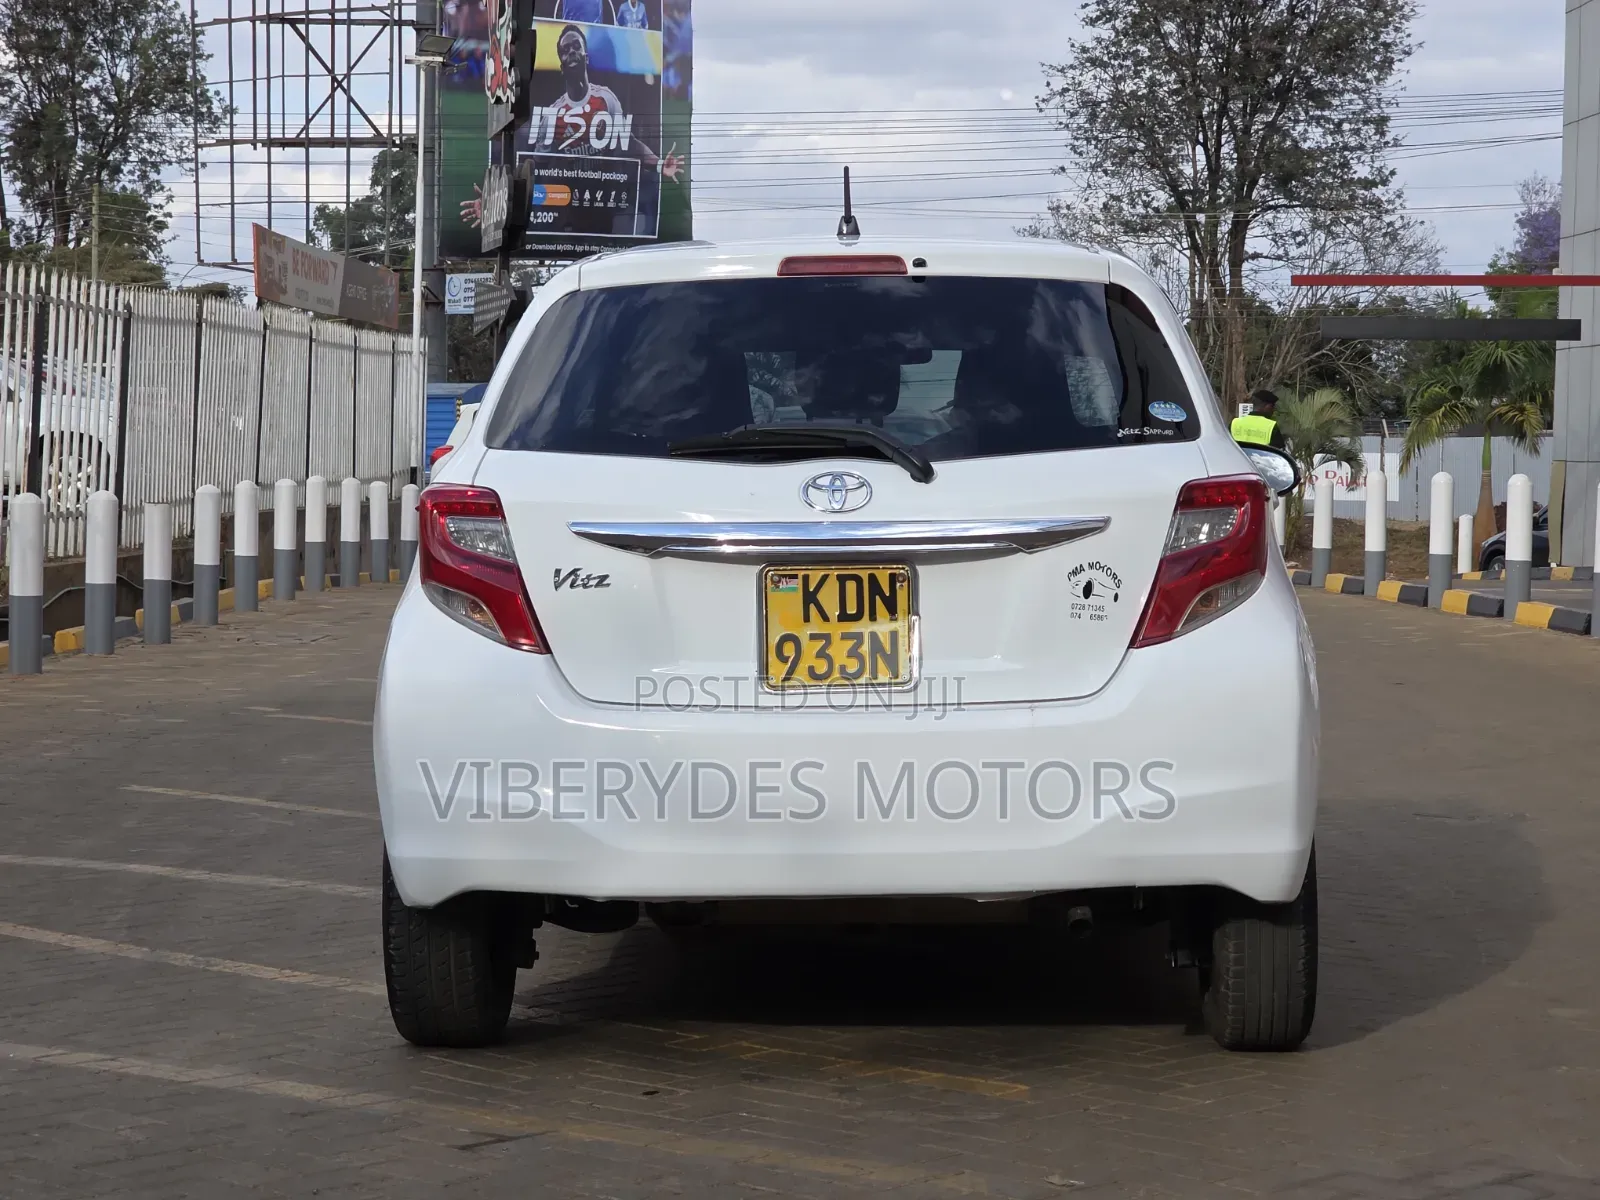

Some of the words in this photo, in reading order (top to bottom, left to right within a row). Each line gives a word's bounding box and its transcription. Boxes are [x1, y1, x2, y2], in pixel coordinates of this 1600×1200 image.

[528, 104, 590, 150] IT'S
[589, 111, 633, 151] ON
[540, 168, 562, 177] world's
[564, 169, 577, 178] best
[578, 169, 601, 179] football
[602, 172, 628, 182] package
[532, 243, 557, 251] Download
[575, 244, 584, 252] App
[590, 245, 599, 253] stay
[301, 249, 329, 286] FORWARD
[554, 567, 611, 591] Vitz
[1067, 563, 1085, 582] PMA
[1088, 561, 1122, 589] MOTORS
[801, 572, 898, 623] KDN
[1071, 603, 1086, 611] 0728
[1070, 612, 1081, 620] 074
[775, 631, 899, 682] 933N
